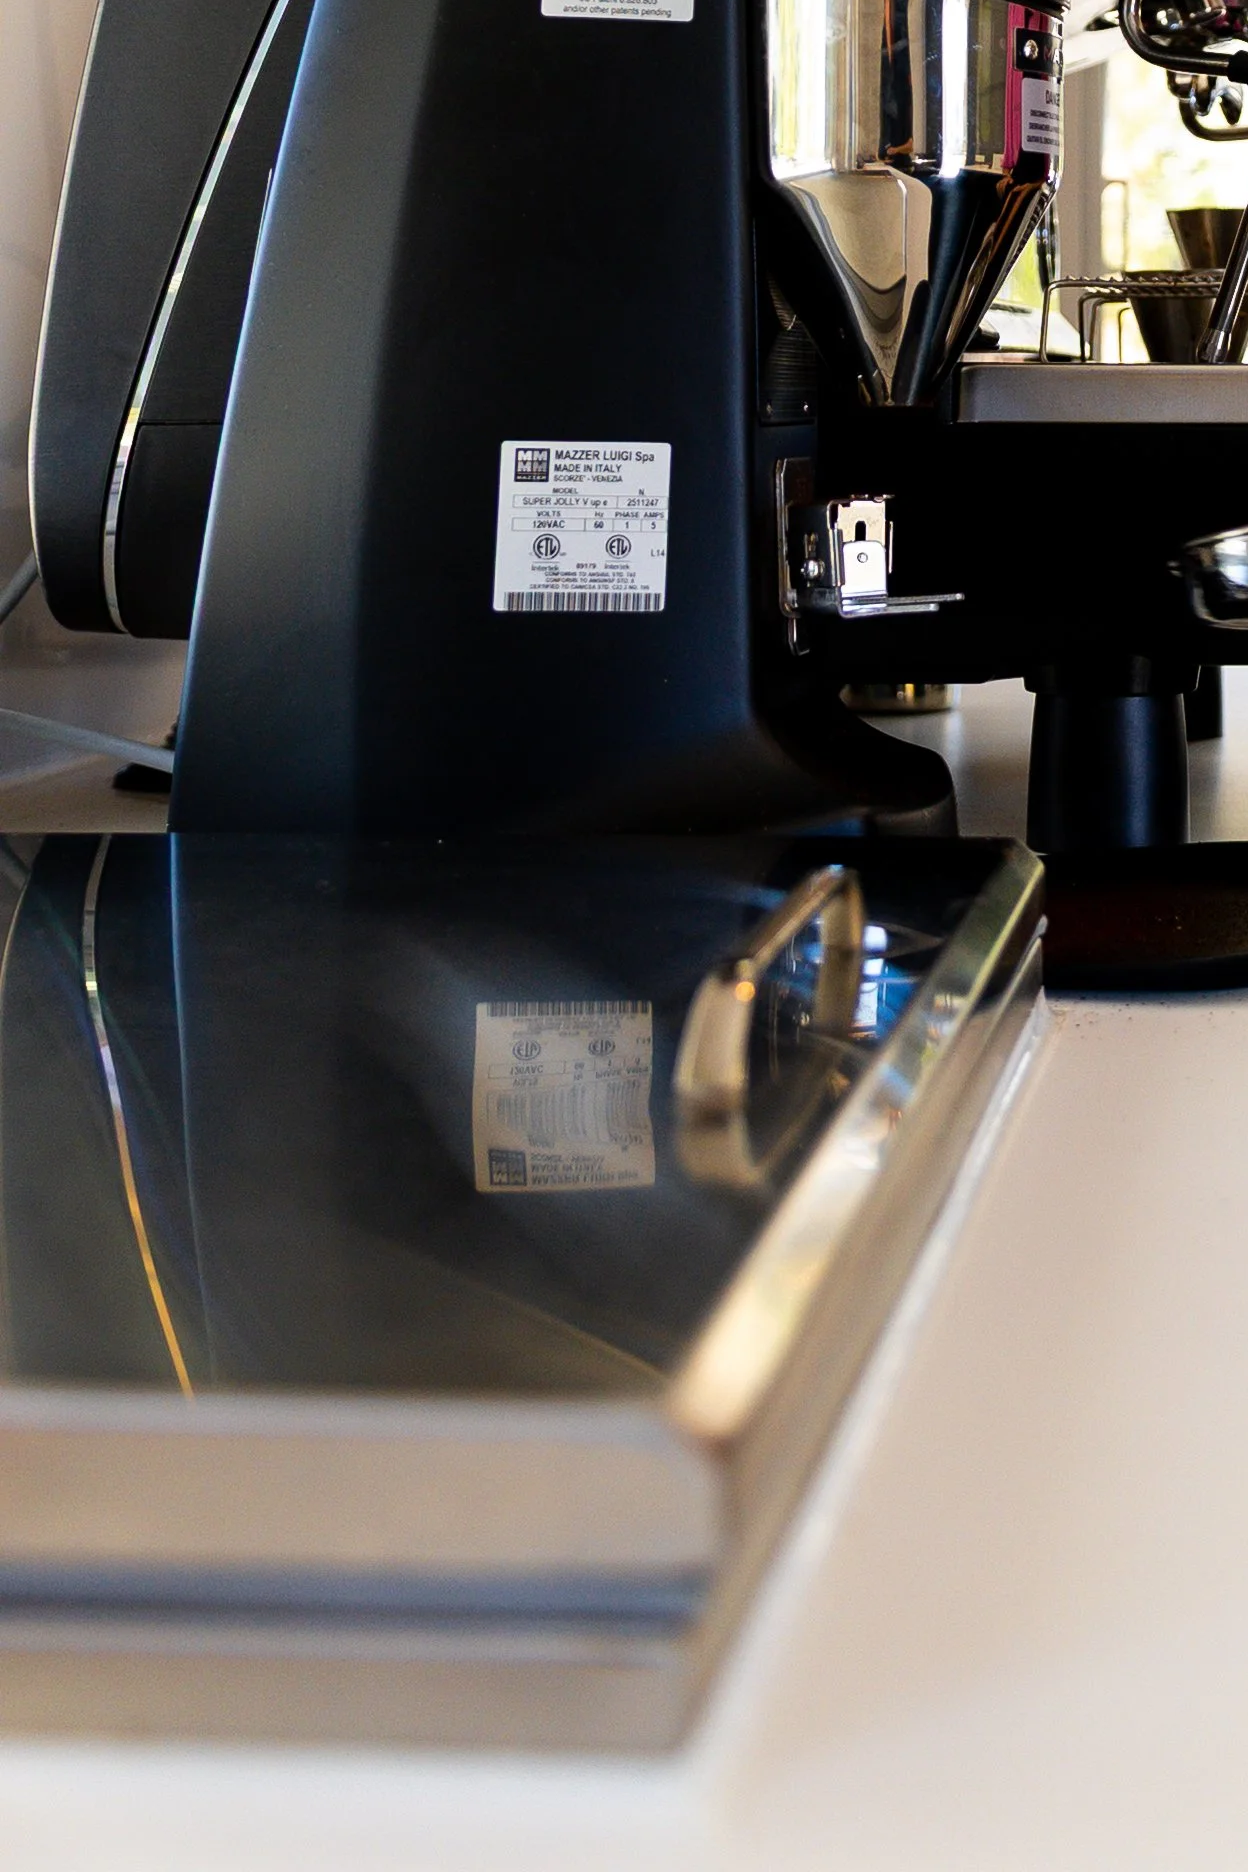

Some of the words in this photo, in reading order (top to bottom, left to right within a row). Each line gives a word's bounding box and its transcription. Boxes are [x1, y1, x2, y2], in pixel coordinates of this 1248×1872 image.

[610, 7, 640, 16] patents
[641, 9, 671, 18] pending
[554, 450, 600, 460] MAZZER
[603, 450, 632, 461] LUIGI
[635, 451, 655, 464] Spa
[553, 463, 581, 472] MADE
[583, 464, 593, 472] IN
[595, 464, 622, 473] ITALY
[522, 496, 552, 505] SUPER
[554, 497, 580, 506] JOLLY
[582, 497, 589, 506] V
[532, 520, 566, 529] 120VAC
[650, 521, 657, 530] 5
[536, 536, 557, 557] ETL
[608, 537, 629, 557] ETL
